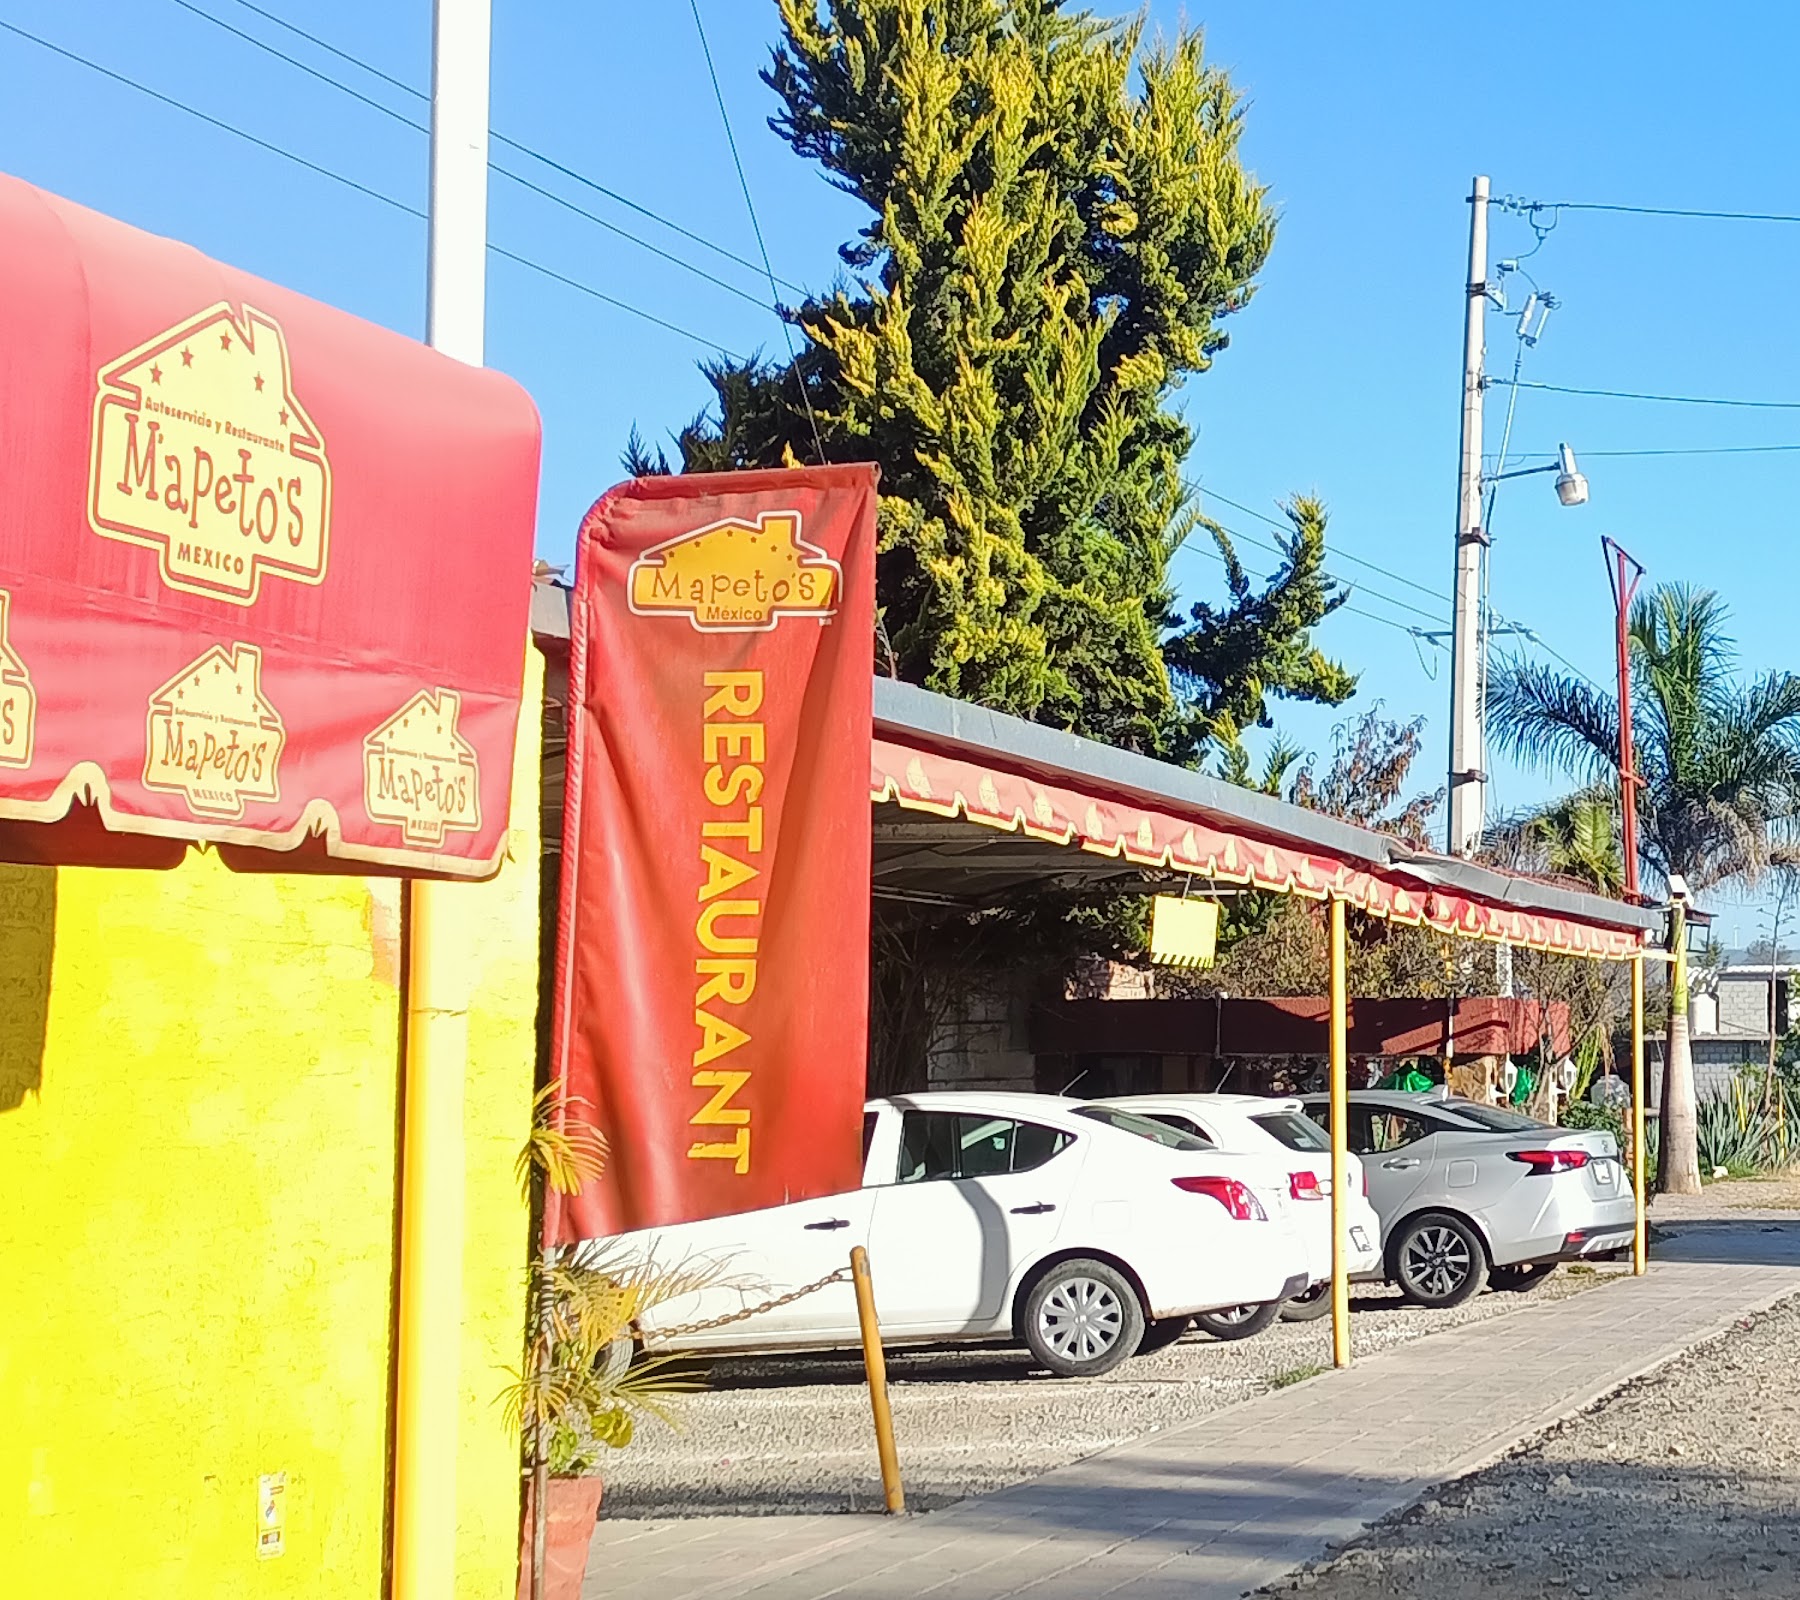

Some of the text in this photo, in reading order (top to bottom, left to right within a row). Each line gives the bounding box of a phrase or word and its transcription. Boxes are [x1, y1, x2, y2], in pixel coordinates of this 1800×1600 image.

[144, 395, 285, 453] Autoservicio y Restaurante
[176, 542, 244, 575] MEXICO
[687, 669, 766, 1176] RESTAURANT
